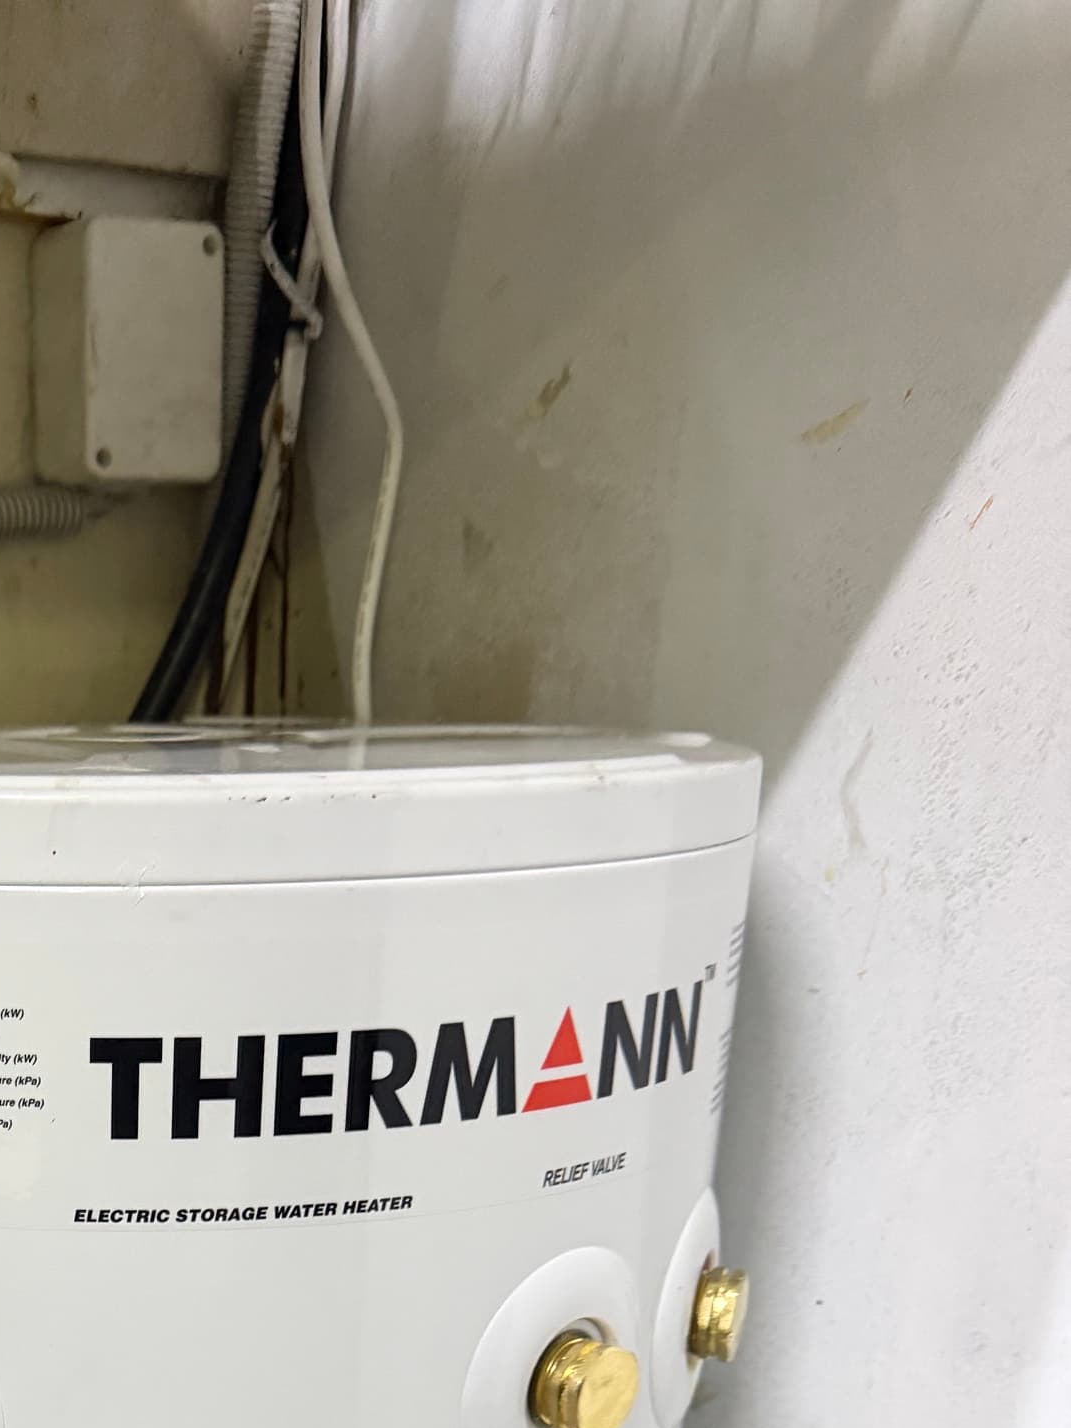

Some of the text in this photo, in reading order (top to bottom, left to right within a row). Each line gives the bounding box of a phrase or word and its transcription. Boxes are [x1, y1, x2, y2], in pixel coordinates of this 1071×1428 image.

[0, 1008, 25, 1020] (kW)
[13, 1054, 38, 1065] (kW)
[89, 979, 704, 1140] THERMANN
[14, 1076, 41, 1087] (kPa)
[18, 1098, 45, 1110] (kPa)
[542, 1151, 627, 1188] RELIEF VALVE
[74, 1195, 413, 1223] ELECTRIC STORAGE WATER HEATER
